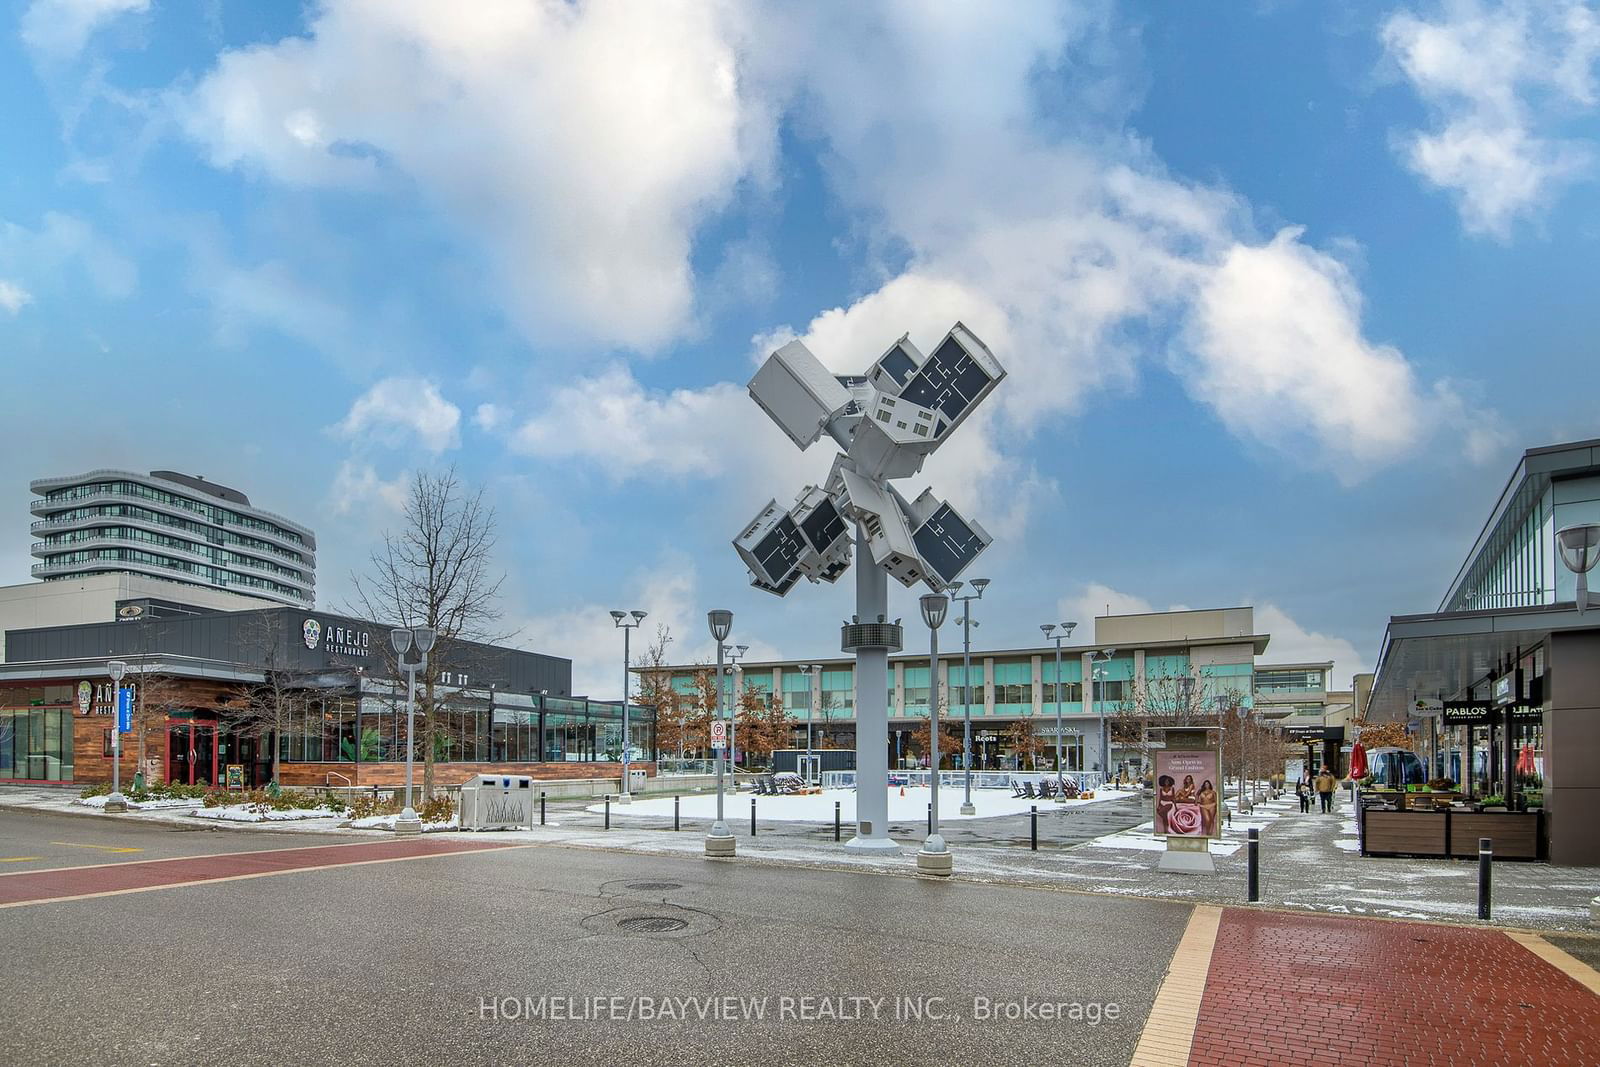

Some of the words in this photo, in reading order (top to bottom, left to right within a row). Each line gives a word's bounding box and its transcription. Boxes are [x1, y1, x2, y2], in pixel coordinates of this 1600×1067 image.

[325, 626, 369, 647] AÑEJO
[325, 644, 369, 657] RESTAURANT
[96, 683, 136, 702] AÑO
[1446, 706, 1487, 716] PABLO'S
